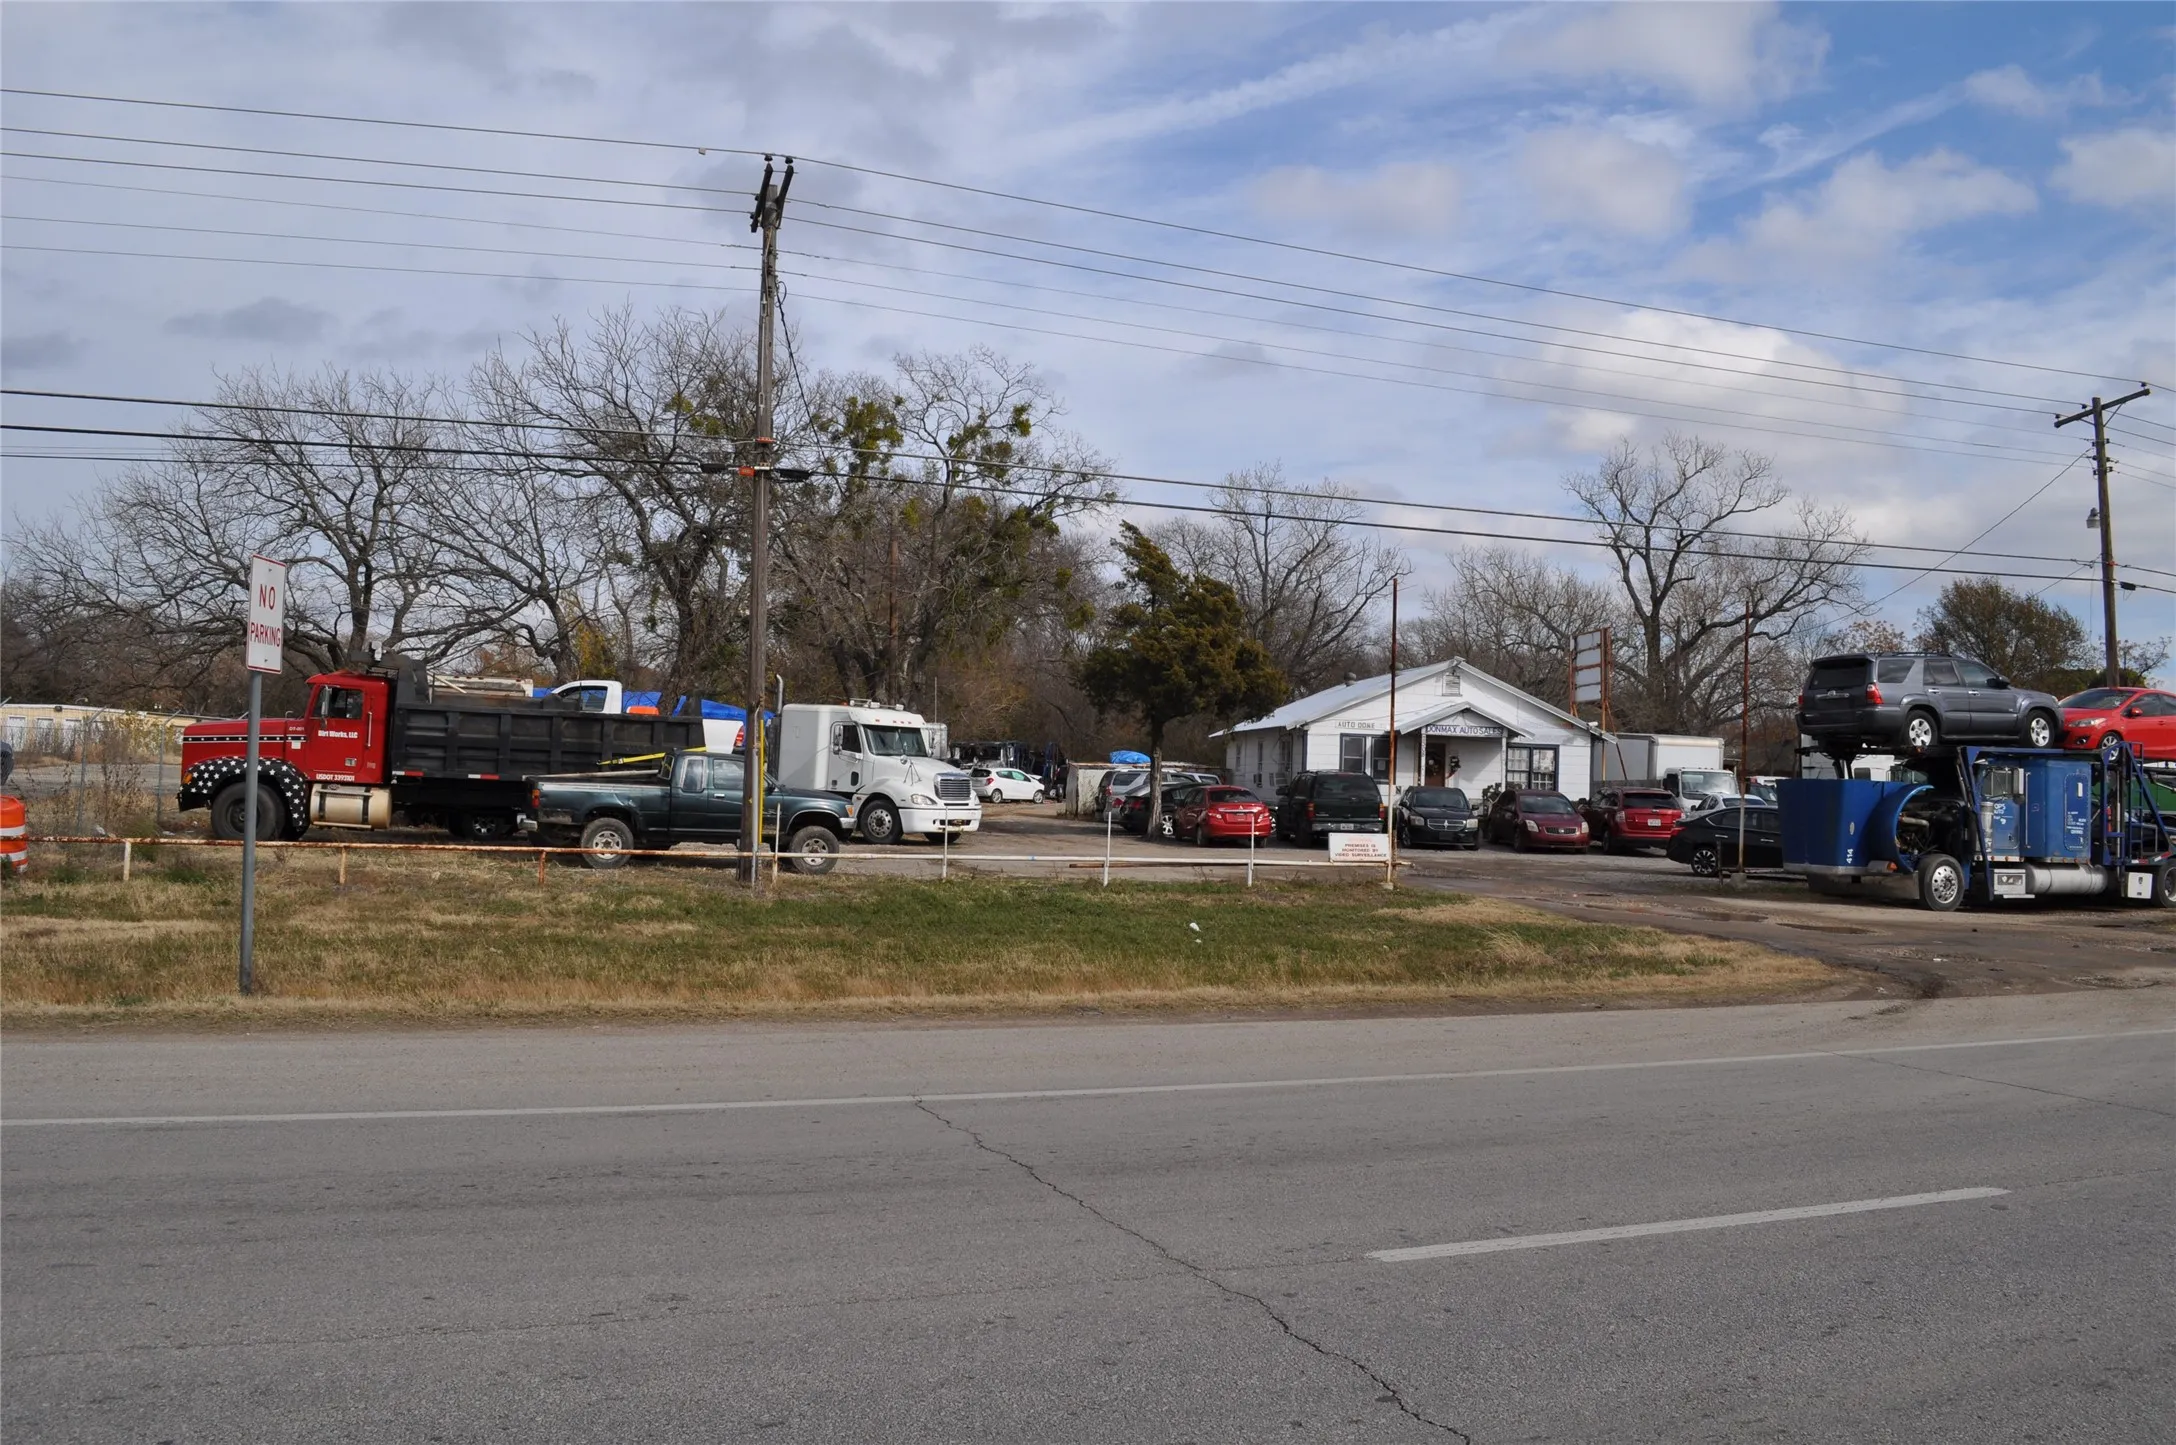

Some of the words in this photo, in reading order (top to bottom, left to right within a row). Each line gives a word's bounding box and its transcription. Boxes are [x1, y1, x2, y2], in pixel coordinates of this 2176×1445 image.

[259, 584, 276, 610] NO
[250, 622, 281, 647] PARKING
[349, 731, 358, 739] LLC
[1426, 725, 1457, 734] DONMAX
[1459, 726, 1479, 735] AUTO
[1480, 727, 1503, 735] SALES
[316, 773, 333, 781] USDOT
[1846, 848, 1854, 864] 414
